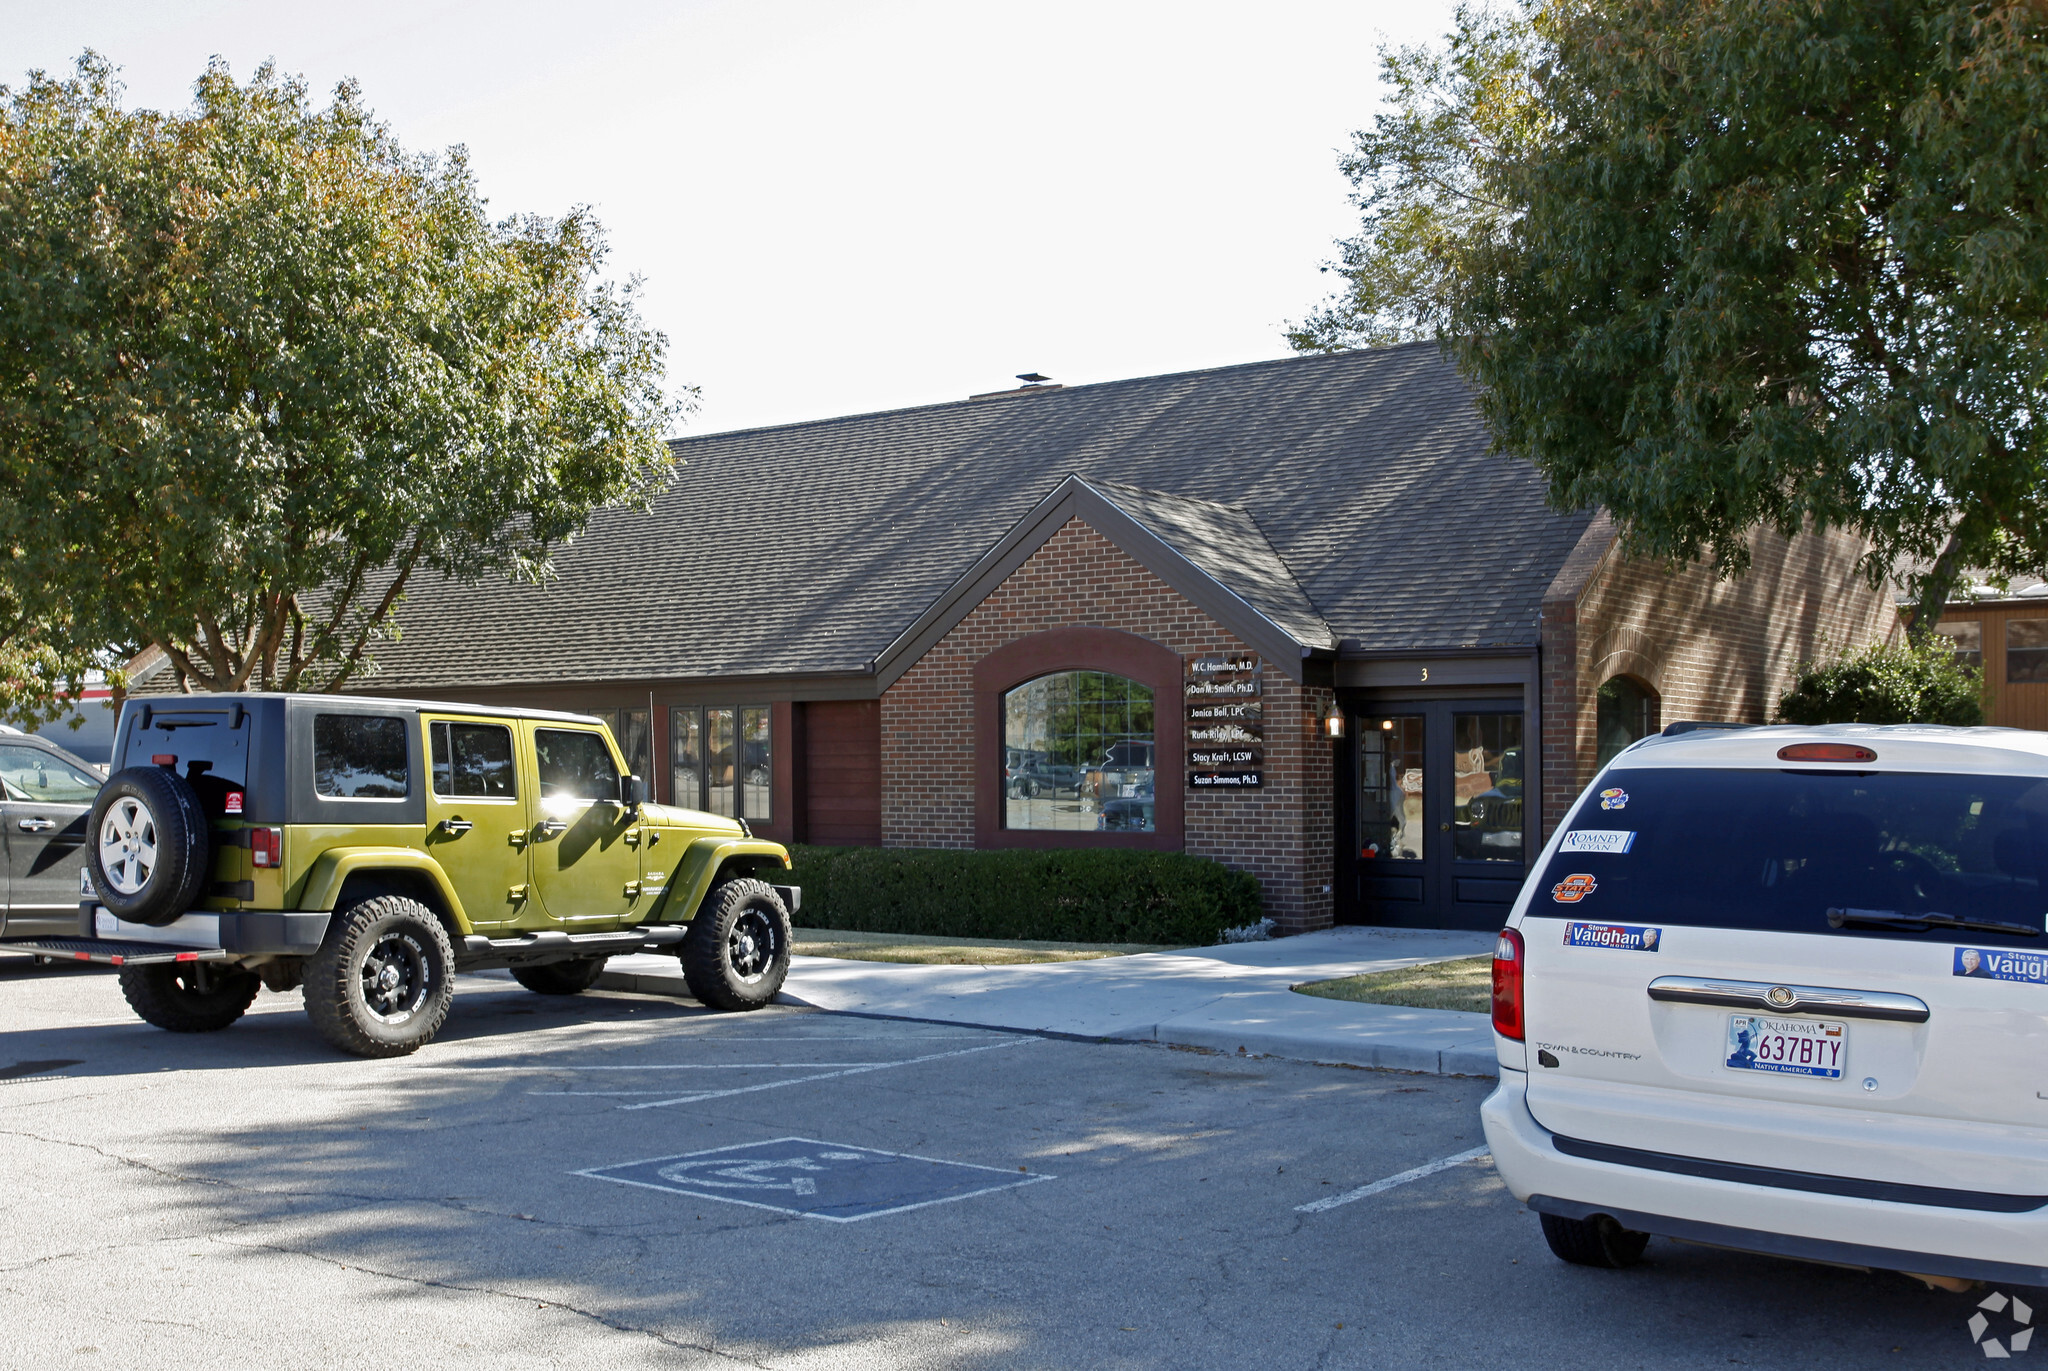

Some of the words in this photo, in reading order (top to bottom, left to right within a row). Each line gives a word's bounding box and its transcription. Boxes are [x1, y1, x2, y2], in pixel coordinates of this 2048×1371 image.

[1191, 662, 1206, 672] W.C.
[1207, 661, 1238, 672] Hamilton,
[1239, 661, 1254, 670] M.D.
[1420, 667, 1428, 682] 3
[1191, 685, 1204, 693] Dan
[1205, 684, 1213, 693] M.
[1215, 684, 1236, 694] Smith,
[1237, 683, 1254, 693] Ph.D.
[1191, 708, 1212, 717] Janice
[1214, 707, 1229, 717] Bell,
[1231, 707, 1244, 716] LPC
[1192, 730, 1208, 739] Ruth
[1231, 729, 1244, 739] LPC
[1193, 752, 1210, 763] Stacy
[1211, 752, 1231, 762] Kraft,
[1233, 752, 1252, 761] LCSW
[1194, 775, 1212, 784] Suzan
[1213, 775, 1241, 785] Simmons,
[1243, 774, 1258, 784] Ph.D.
[1567, 832, 1622, 846] ROMNEY
[1554, 884, 1595, 892] STATE
[1574, 927, 1640, 945] Vaughan
[2007, 952, 2039, 961] Steve
[1994, 973, 2029, 982] STATE
[1758, 1020, 1817, 1035] OKLAHOMA
[1536, 1042, 1569, 1052] TOWN
[1580, 1047, 1641, 1060] COUNTRY
[1759, 1035, 1841, 1066] 637BTY
[1754, 1063, 1778, 1071] NATIVE
[1780, 1065, 1813, 1075] AMERICA
